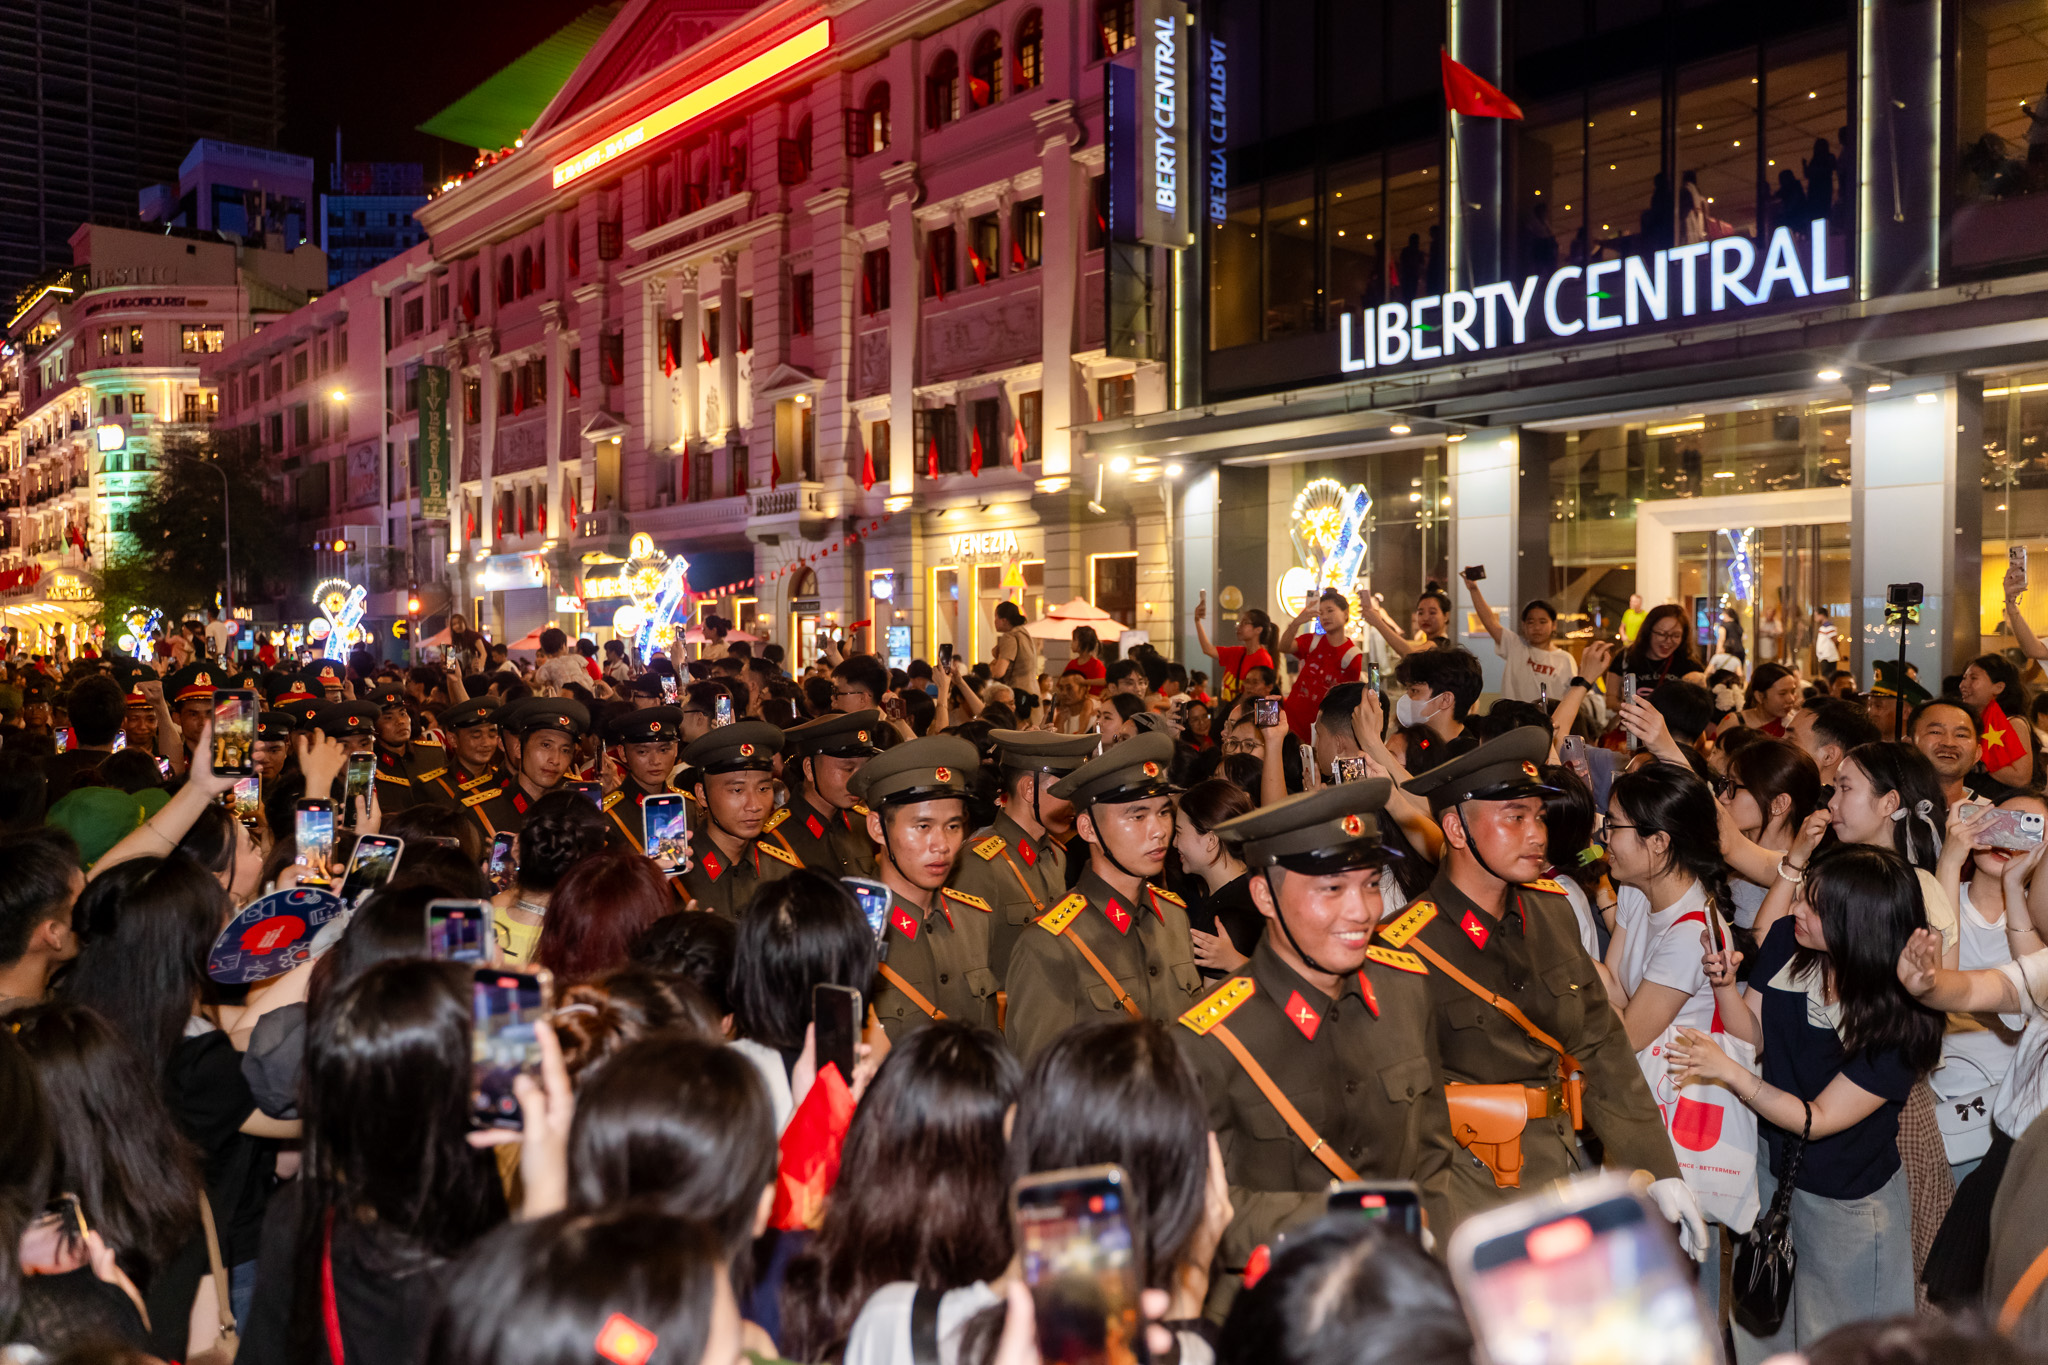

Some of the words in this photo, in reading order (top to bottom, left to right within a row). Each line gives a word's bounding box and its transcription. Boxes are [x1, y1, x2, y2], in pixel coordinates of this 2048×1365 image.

[1154, 16, 1176, 128] CENTRAL
[1155, 127, 1176, 219] IBERTY
[1340, 275, 1539, 372] LIBERTY
[1544, 218, 1851, 337] CENTRAL
[426, 367, 442, 497] RIVERSIDE
[949, 530, 1019, 556] VENEZIA
[1698, 1164, 1739, 1175] BETTERMENT
